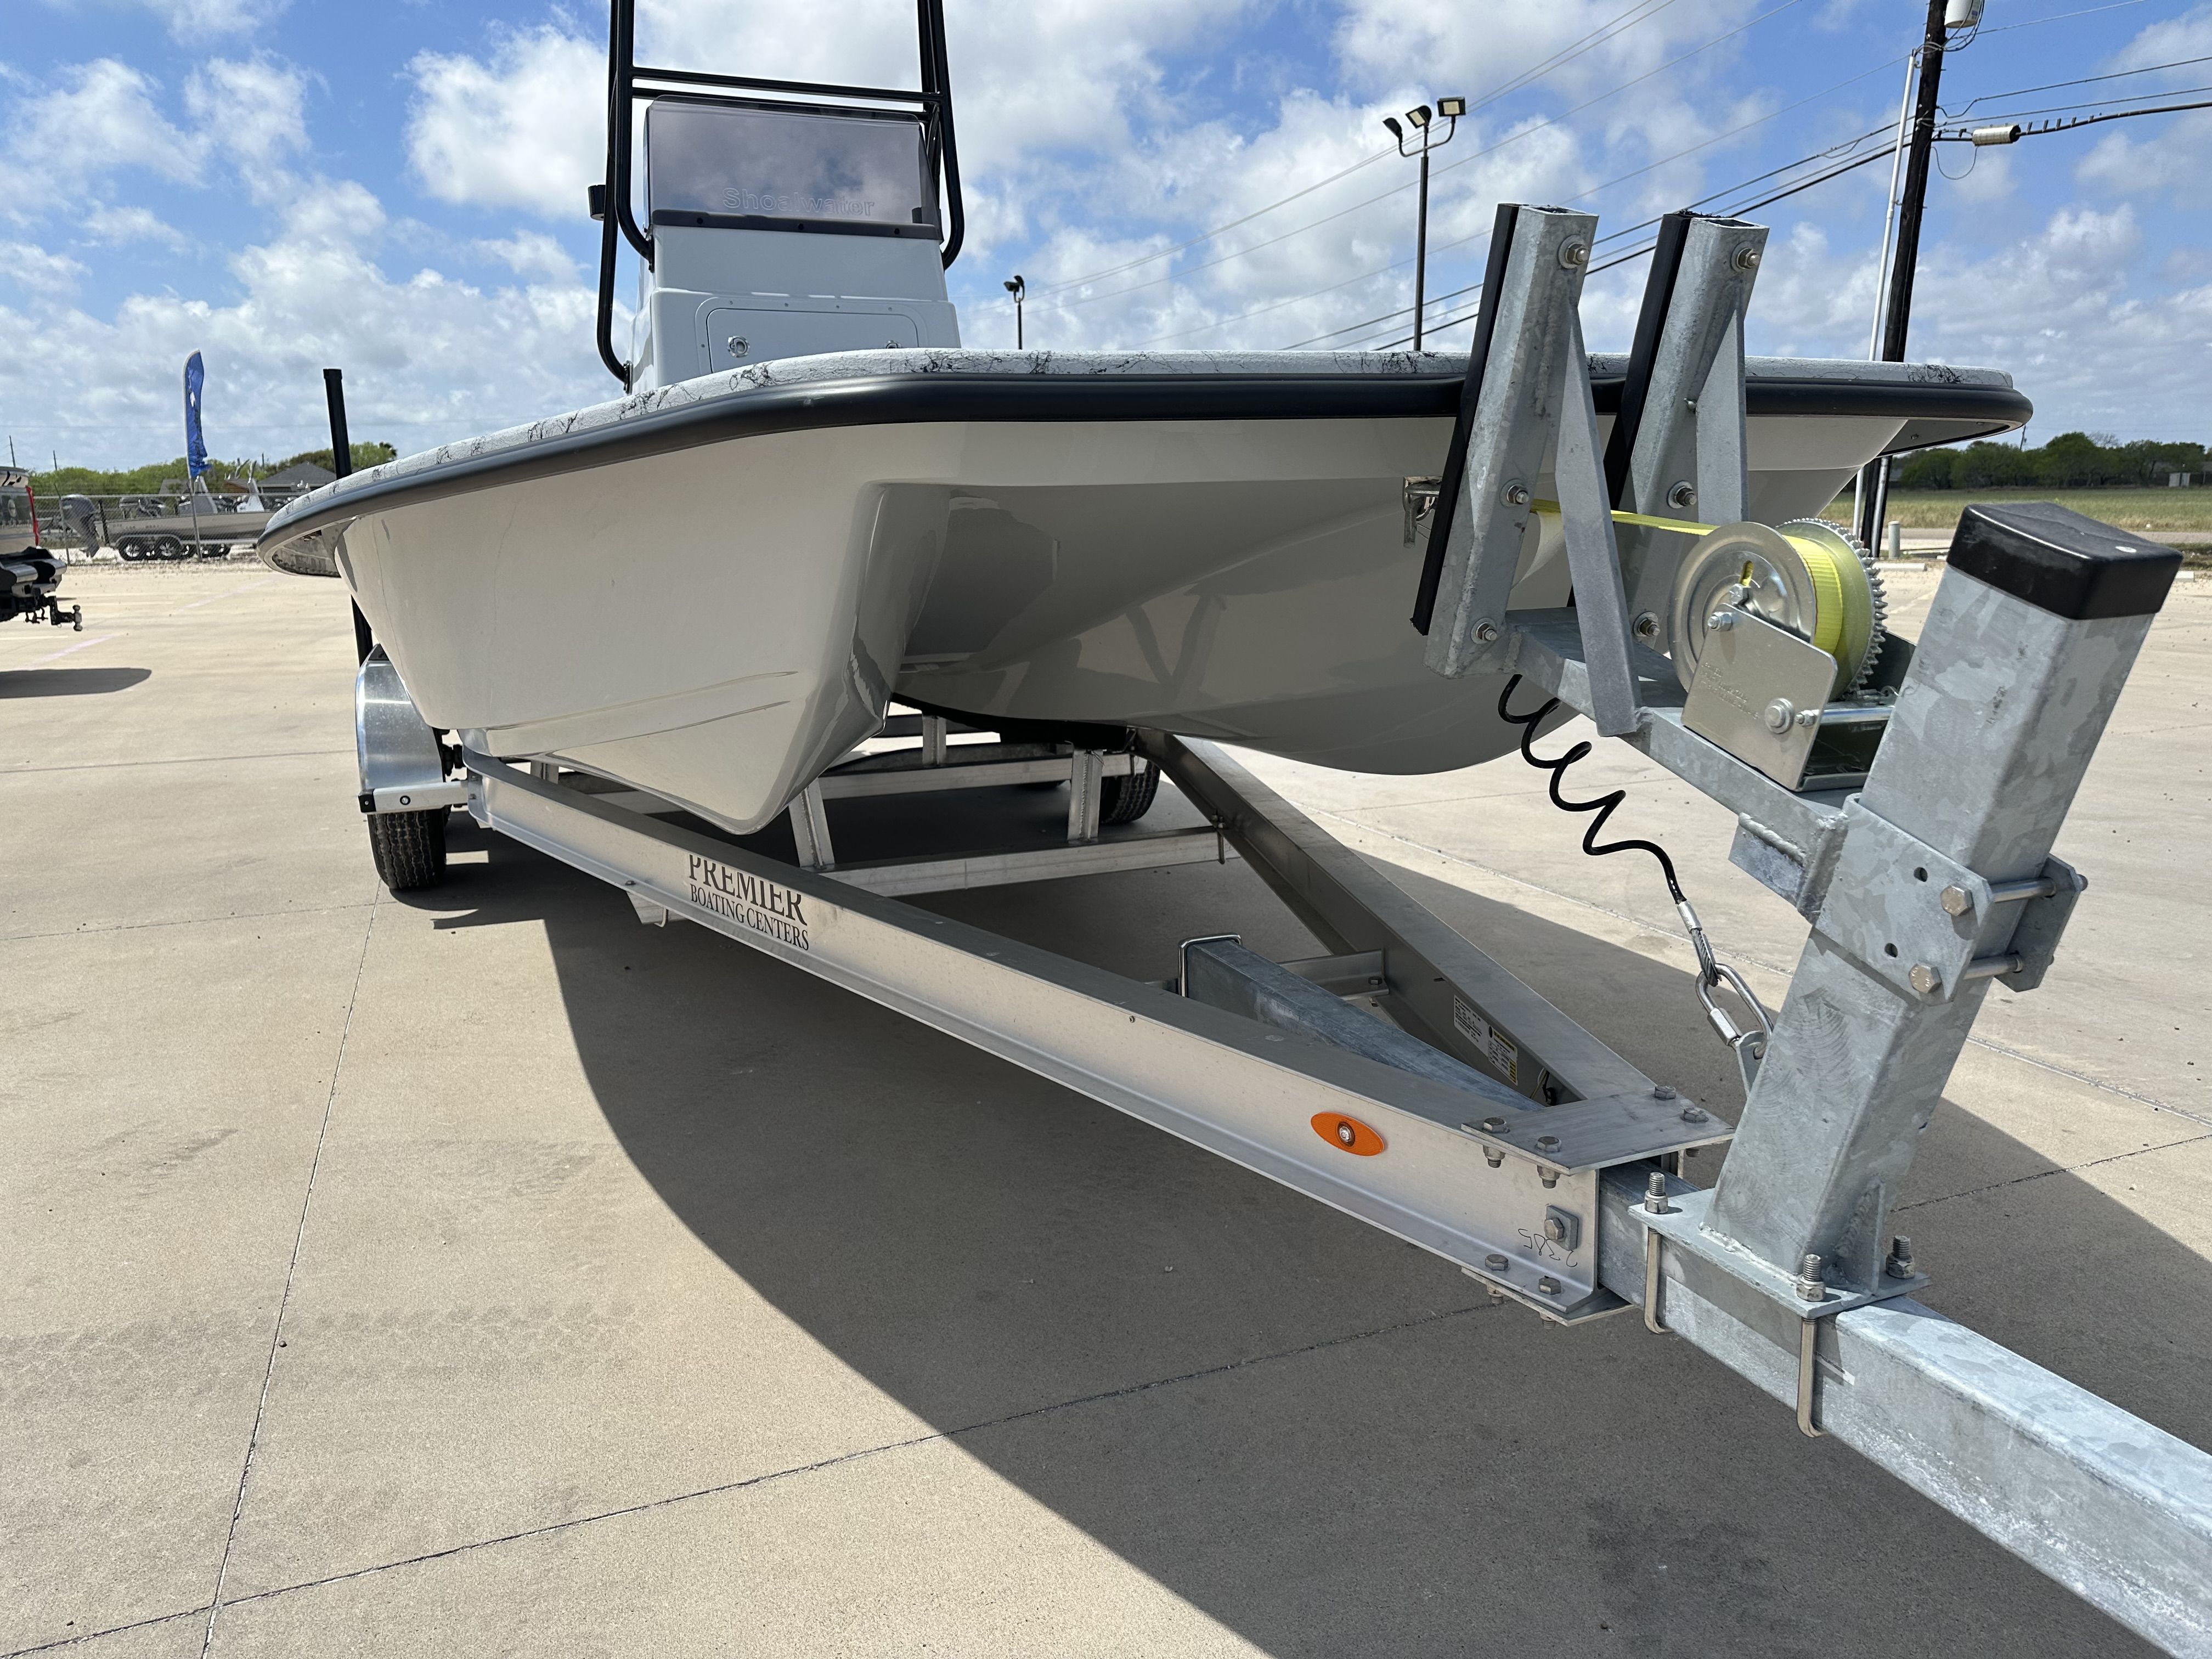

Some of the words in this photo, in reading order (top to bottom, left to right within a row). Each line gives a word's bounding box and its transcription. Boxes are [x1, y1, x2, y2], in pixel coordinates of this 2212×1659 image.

[723, 188, 874, 216] Shoalwater
[689, 854, 808, 926] PREMIER
[690, 883, 745, 923] BOATING
[746, 907, 809, 951] CENTERS
